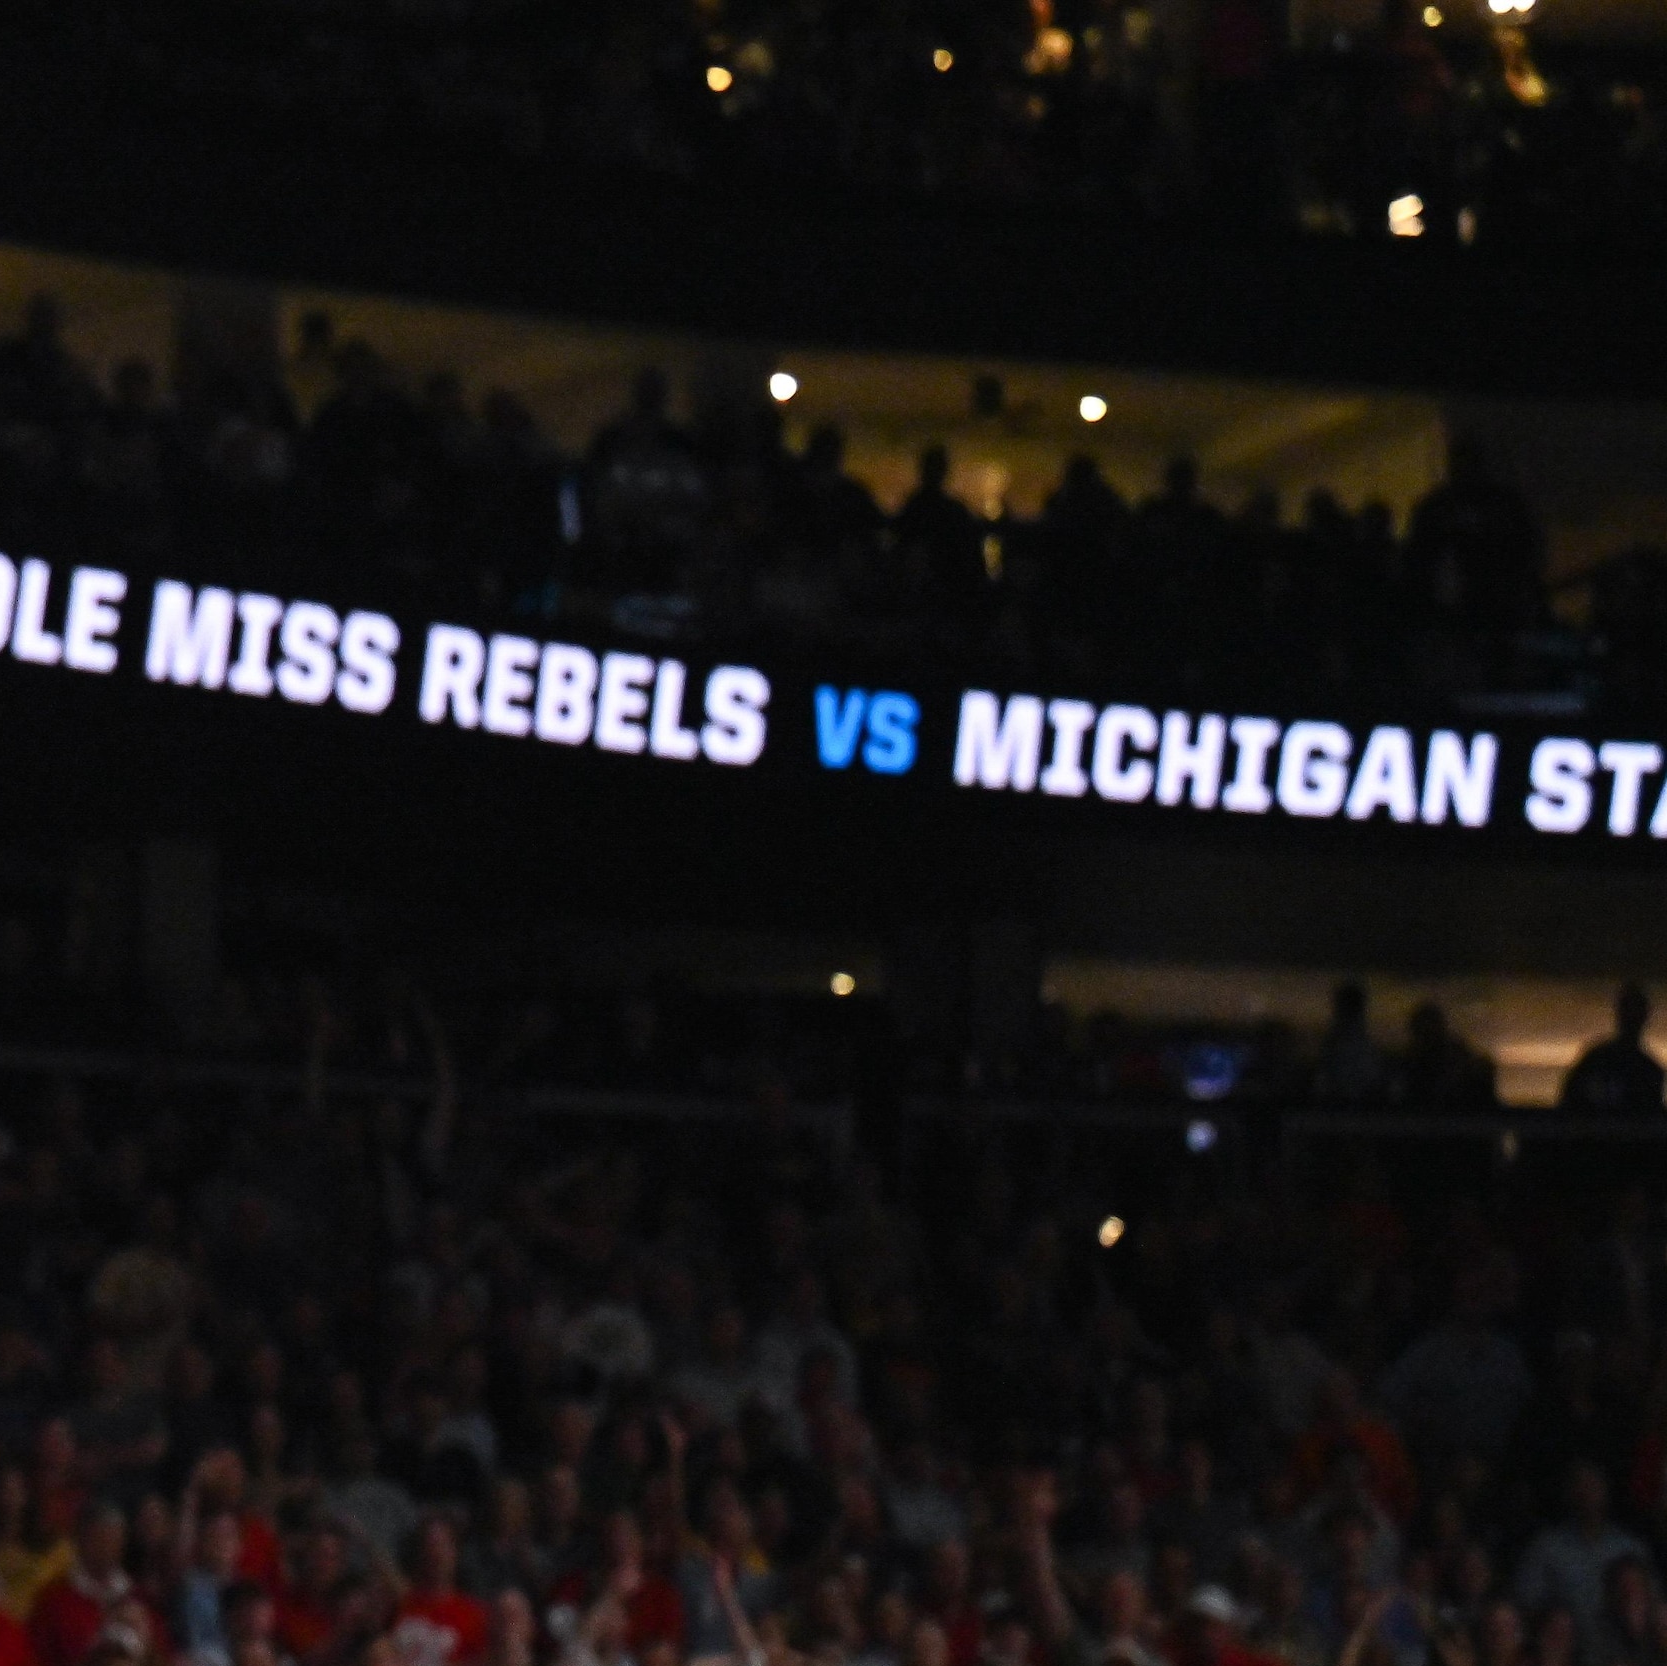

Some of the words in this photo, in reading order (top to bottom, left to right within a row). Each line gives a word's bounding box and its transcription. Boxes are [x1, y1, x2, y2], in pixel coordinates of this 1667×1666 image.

[144, 579, 402, 714] MISS
[418, 622, 772, 767] REBELS
[813, 684, 922, 776] VS
[952, 688, 1499, 828] MICHIGAN
